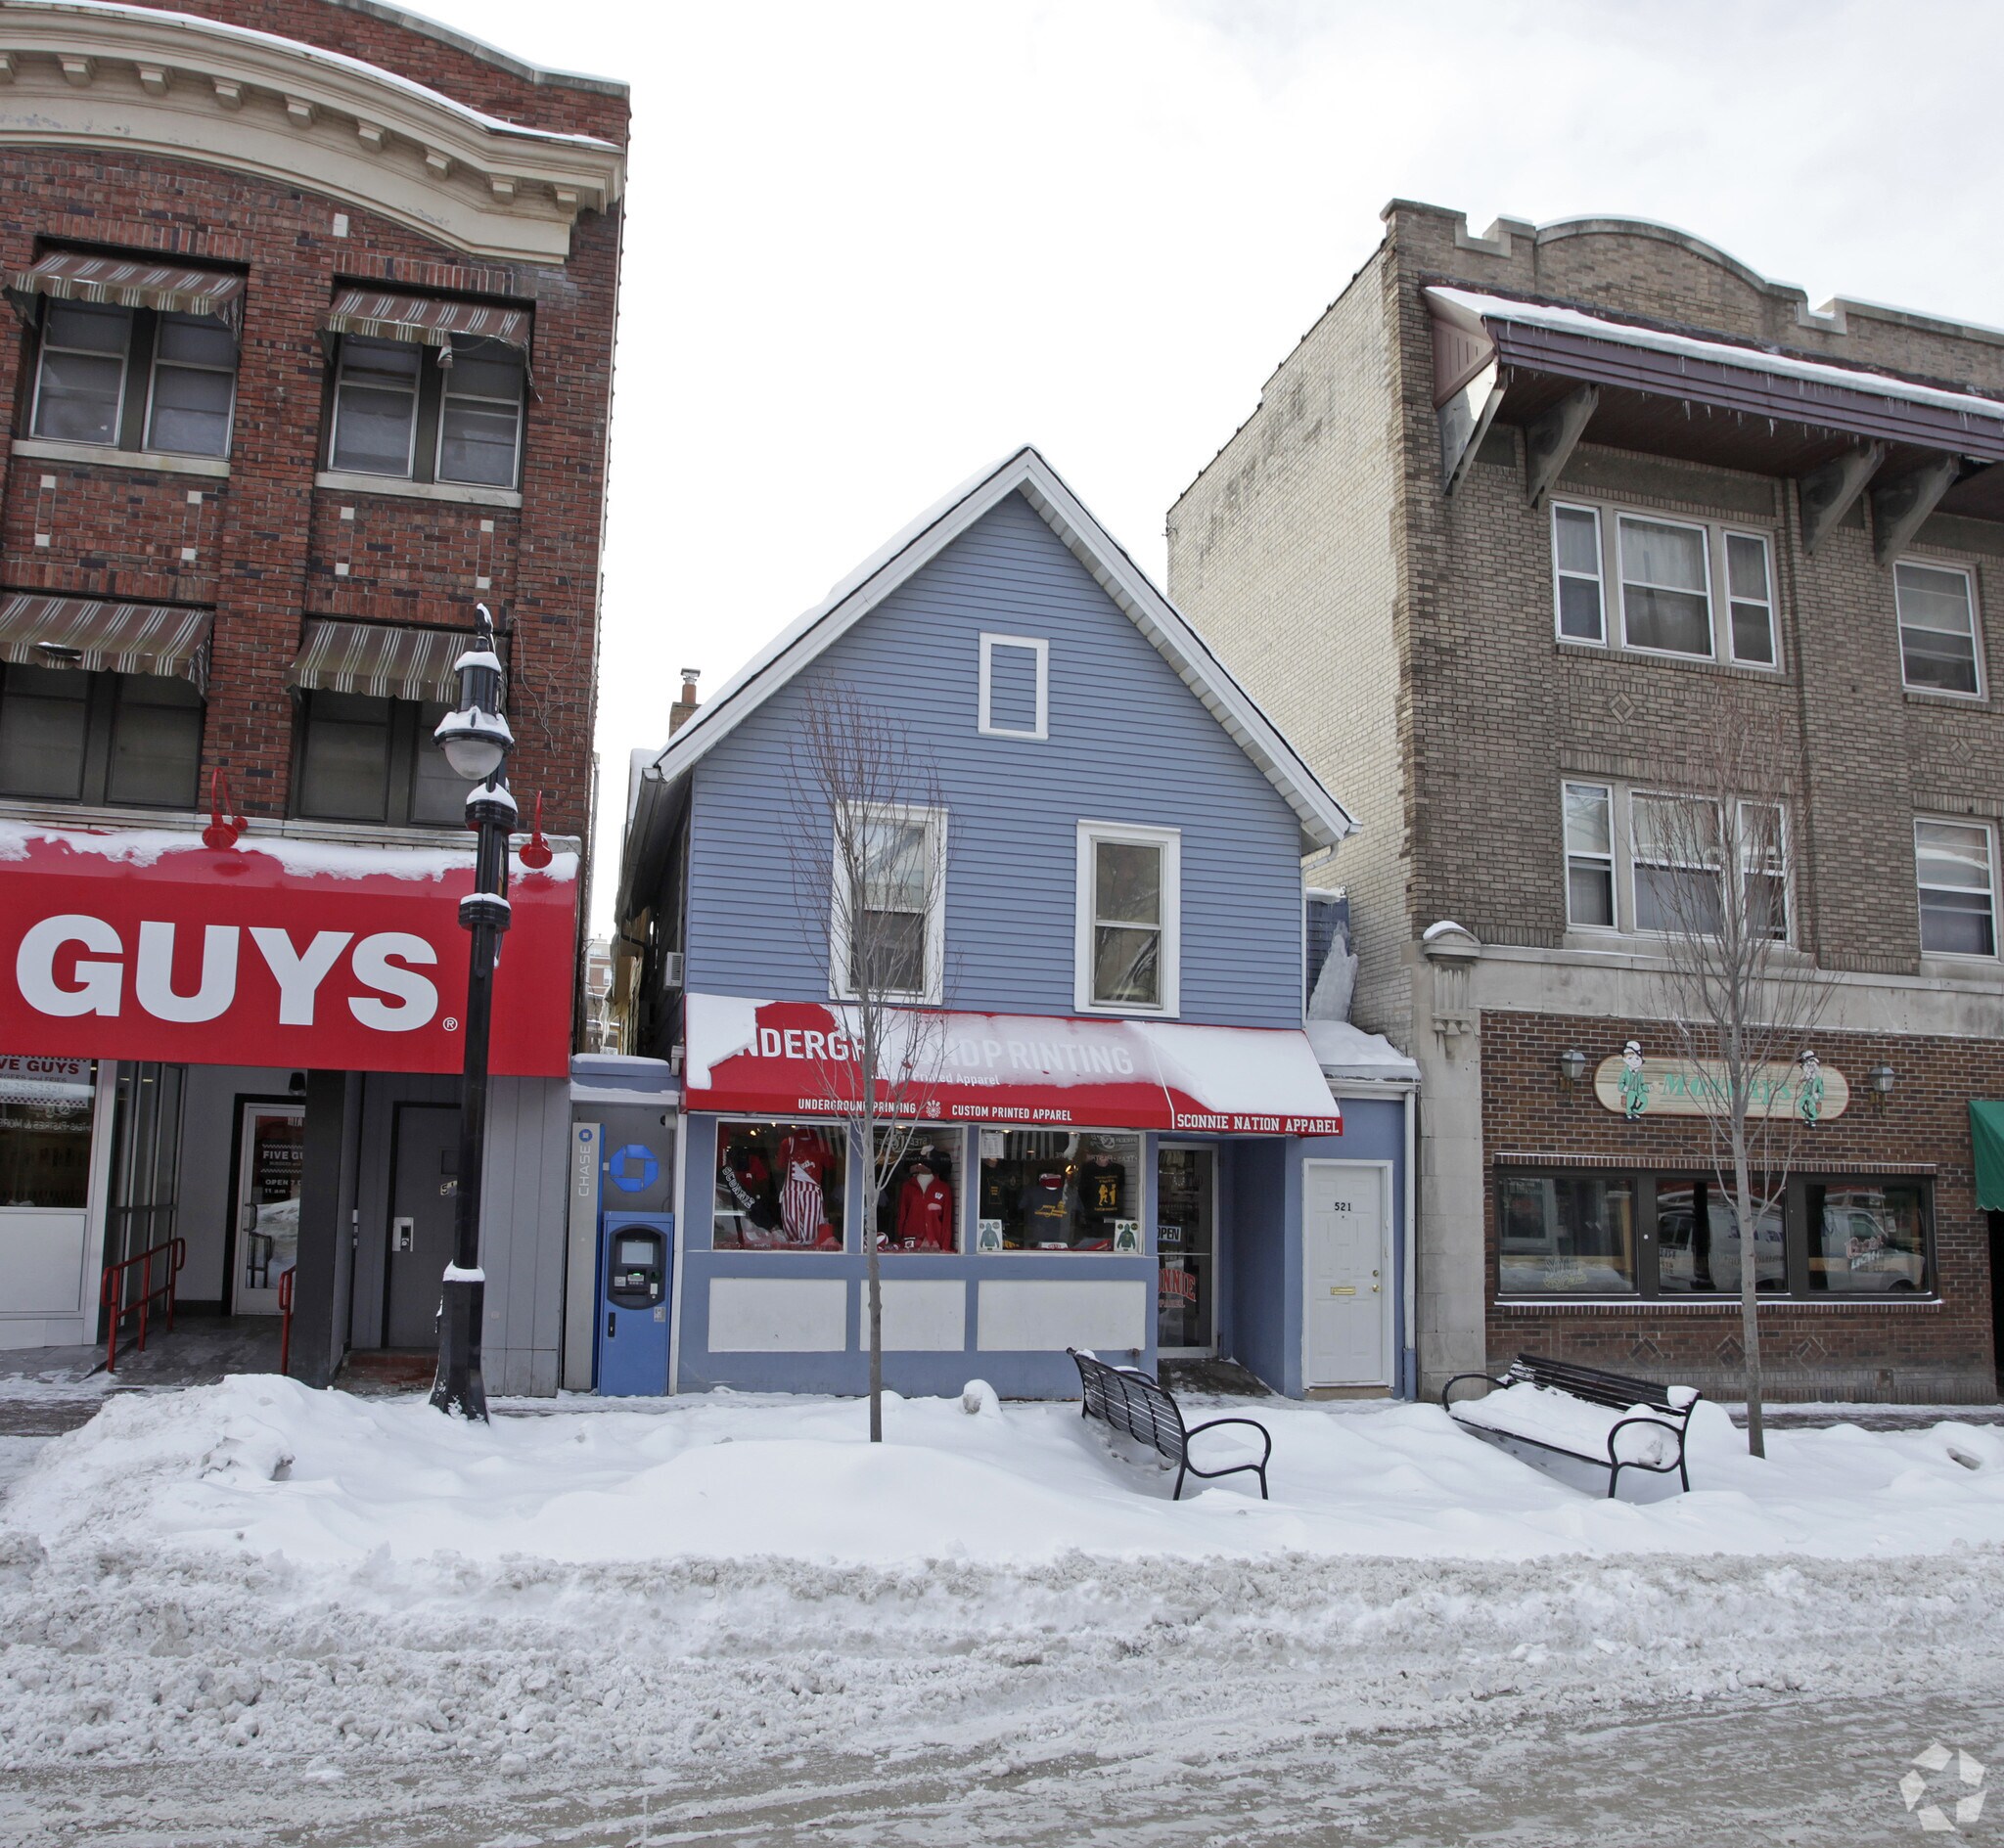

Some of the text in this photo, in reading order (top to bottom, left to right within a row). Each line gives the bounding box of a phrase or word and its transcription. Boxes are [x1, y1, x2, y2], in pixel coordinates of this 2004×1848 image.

[16, 914, 438, 1032] GUYS
[26, 1059, 79, 1075] GUYS
[982, 1039, 1134, 1075] PRINTING
[912, 1069, 953, 1083] Prined
[956, 1072, 1000, 1086] Apparel
[797, 1098, 1072, 1121] UNDERGROUN PRINING CUSTOM PRINTED APPAREL
[1177, 1113, 1340, 1134] SCONNIE NATION APPAREL
[262, 1150, 289, 1159] FIVE
[578, 1145, 591, 1196] CHASE
[1335, 1201, 1351, 1212] 521
